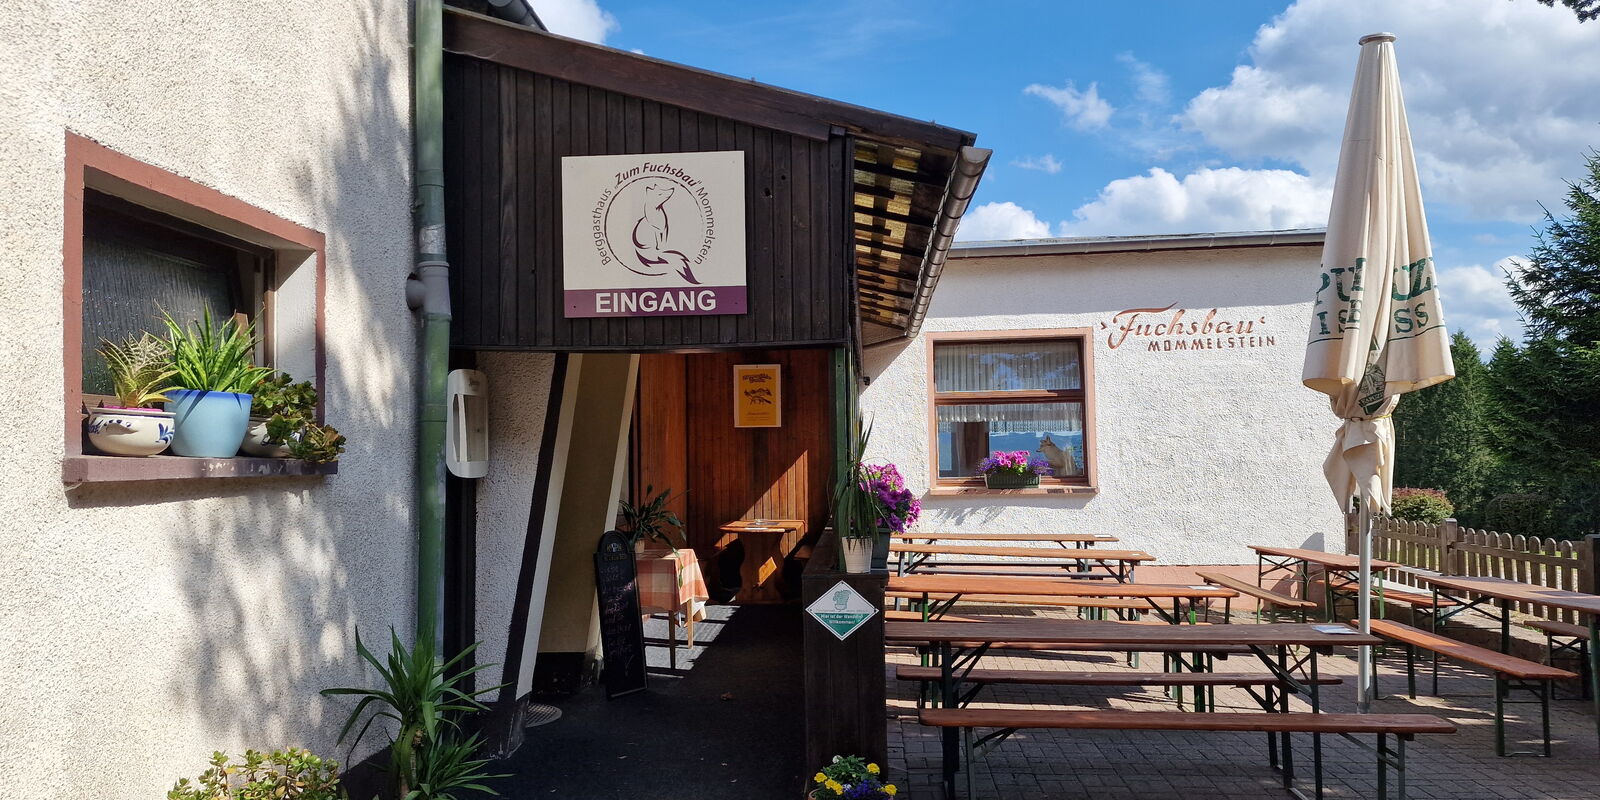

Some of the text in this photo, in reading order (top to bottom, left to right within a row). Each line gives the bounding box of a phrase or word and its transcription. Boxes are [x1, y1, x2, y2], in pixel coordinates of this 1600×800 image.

[592, 188, 612, 266] Berggasthaus
[695, 186, 716, 265] Mommelstein
[595, 289, 717, 313] EINGANG
[1147, 335, 1276, 352] MOMMELSTEIN
